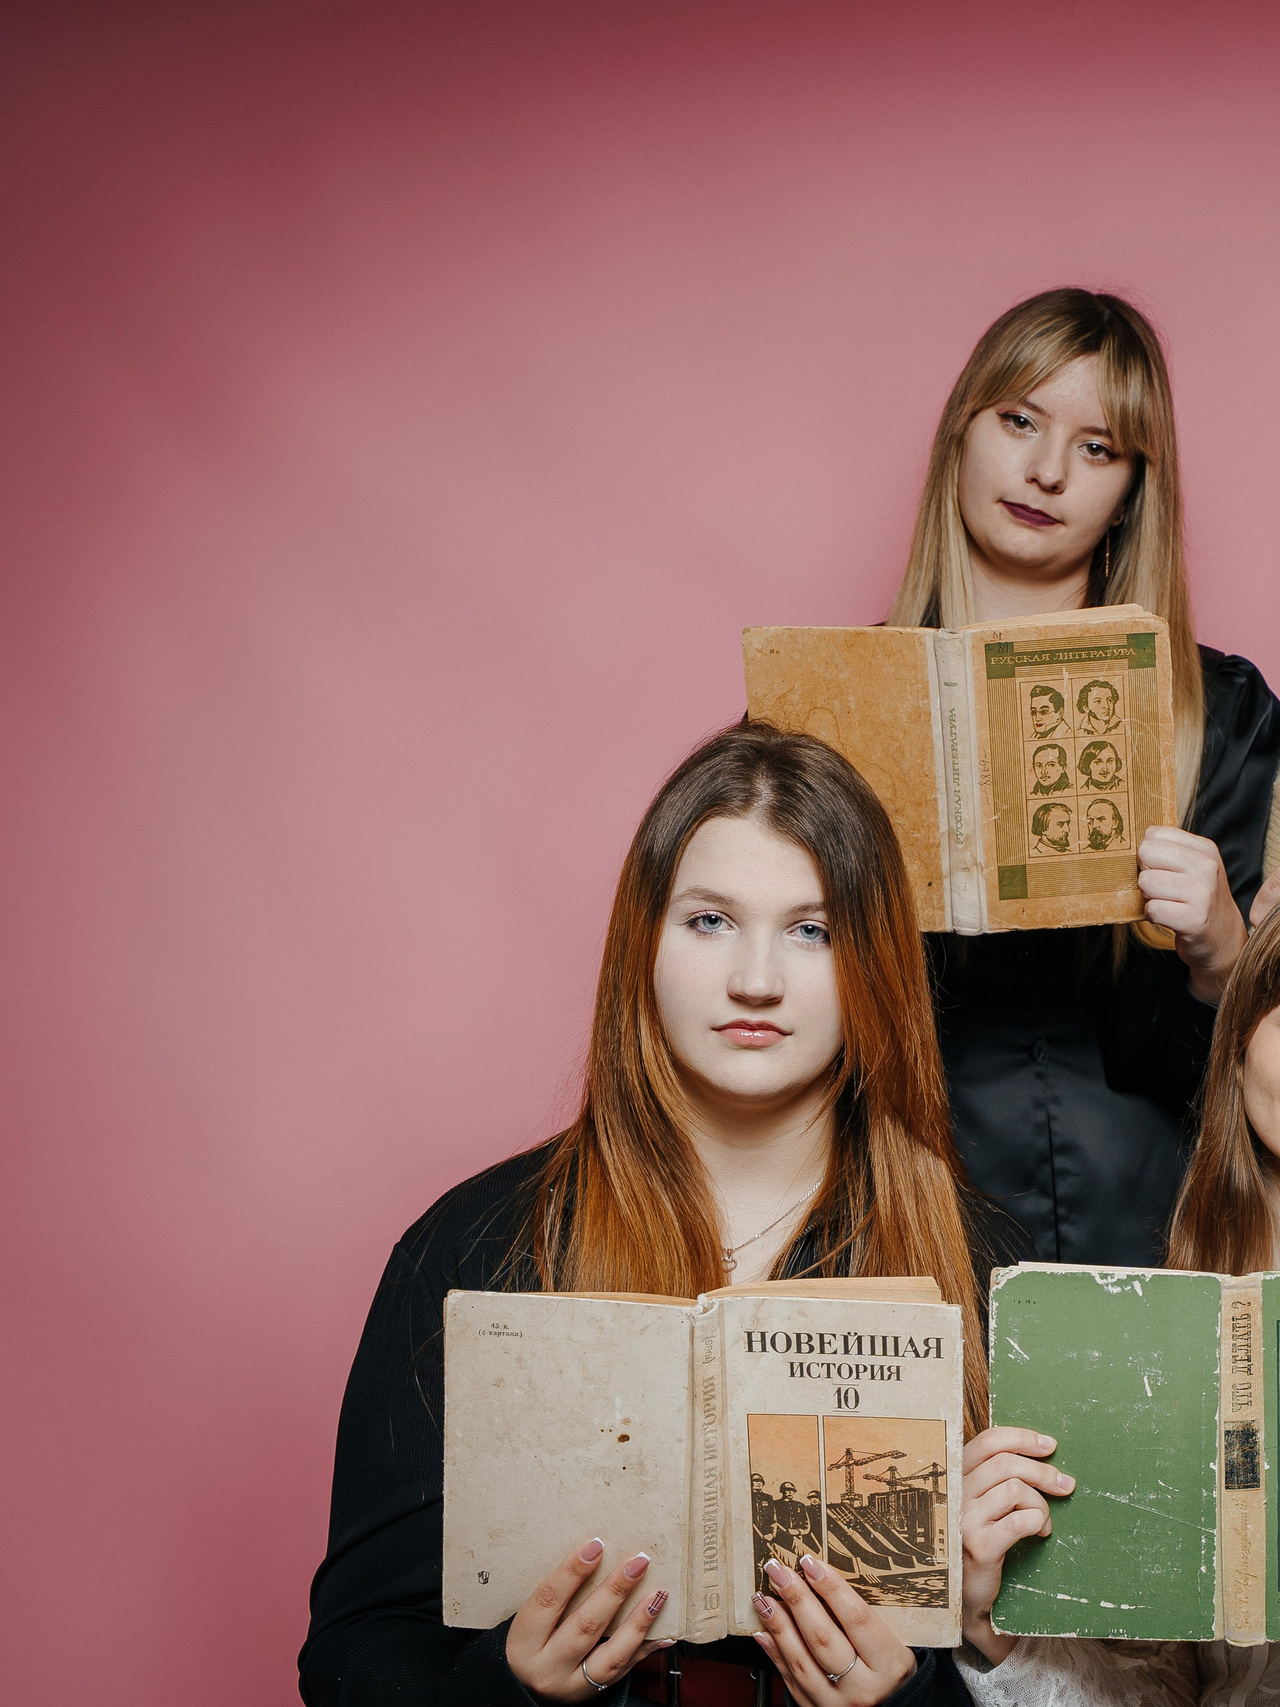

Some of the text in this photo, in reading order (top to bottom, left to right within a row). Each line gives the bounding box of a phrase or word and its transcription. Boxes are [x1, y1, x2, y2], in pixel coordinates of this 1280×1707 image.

[990, 647, 1136, 665] РУССКАЯ ЛИТЕРАТУРА
[949, 707, 964, 845] РУССКАЯ ЛИТЕРАТУРА
[744, 1331, 945, 1359] НОВЕЙШАЯ
[788, 1361, 903, 1382] ИСТОРИЯ
[833, 1386, 860, 1410] 10
[1231, 1382, 1252, 1413] ЧТО
[702, 1374, 718, 1574] НОВЕЙШАЯ ИСТОРИЯ
